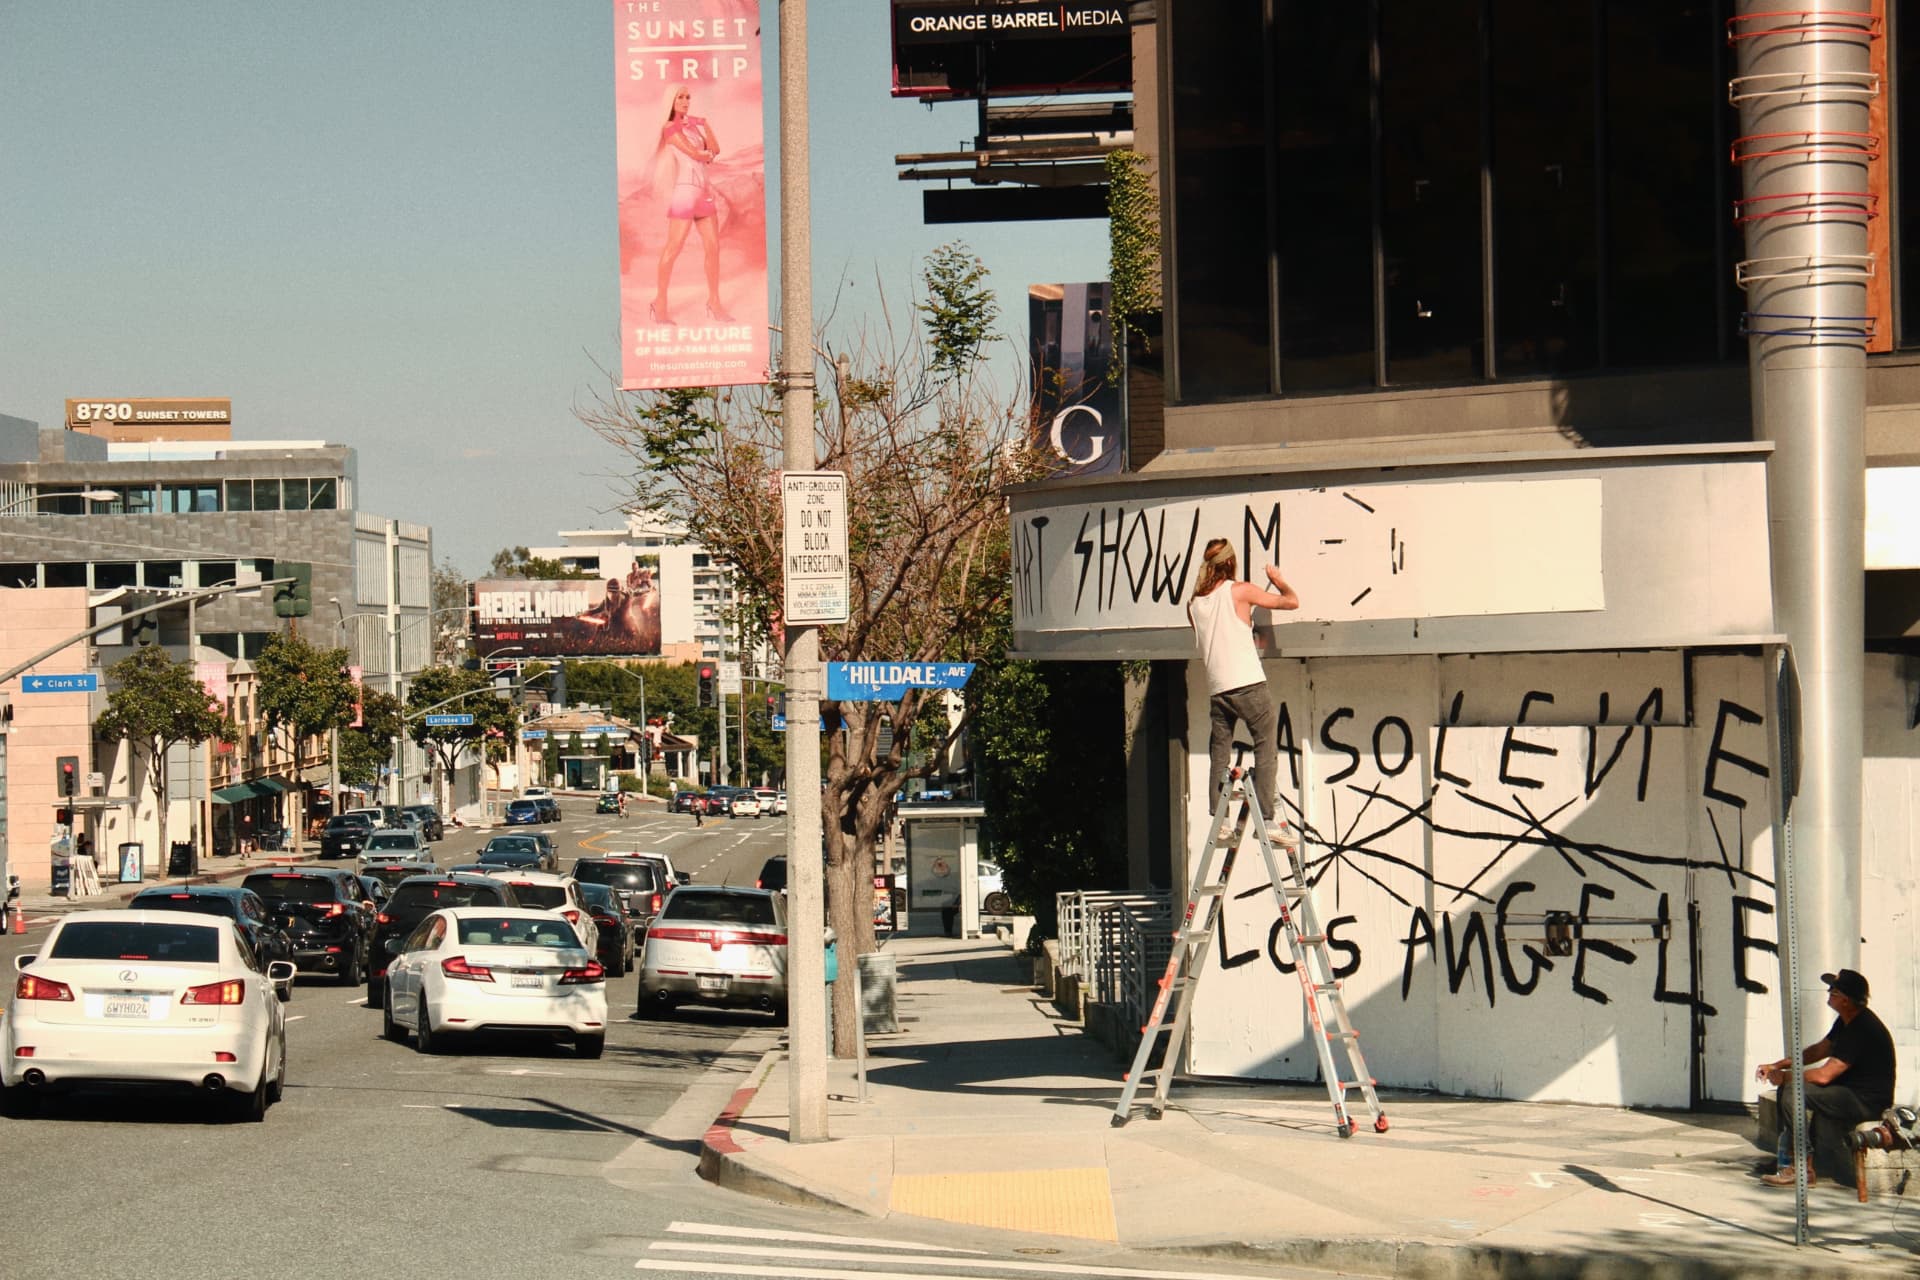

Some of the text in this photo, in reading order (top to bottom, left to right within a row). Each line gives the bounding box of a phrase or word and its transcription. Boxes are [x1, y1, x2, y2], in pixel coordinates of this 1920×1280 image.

[627, 2, 662, 13] THE
[627, 18, 748, 40] SUNSET
[910, 9, 1124, 32] ORANGE BARREL MEDIA
[629, 57, 748, 81] STRIP
[636, 326, 753, 343] THE FUTURE
[76, 403, 227, 420] 8730 SUNSET TOWERS
[1050, 404, 1105, 465] G
[787, 481, 841, 492] ANTI-GRIDLOCK
[806, 494, 825, 505] ZONE
[800, 509, 831, 528] DO NOT
[804, 532, 830, 551] BLOCK
[790, 554, 844, 574] INTERSECTION
[1013, 516, 1050, 617] ART
[1074, 506, 1201, 617] SHOW
[479, 591, 589, 618] REBEL MOON
[47, 679, 87, 688] Clark St
[850, 665, 966, 685] HILLDALE AVE
[774, 719, 787, 728] Sa
[1232, 688, 1770, 808] ASOLENE
[1219, 903, 1361, 979] LOS
